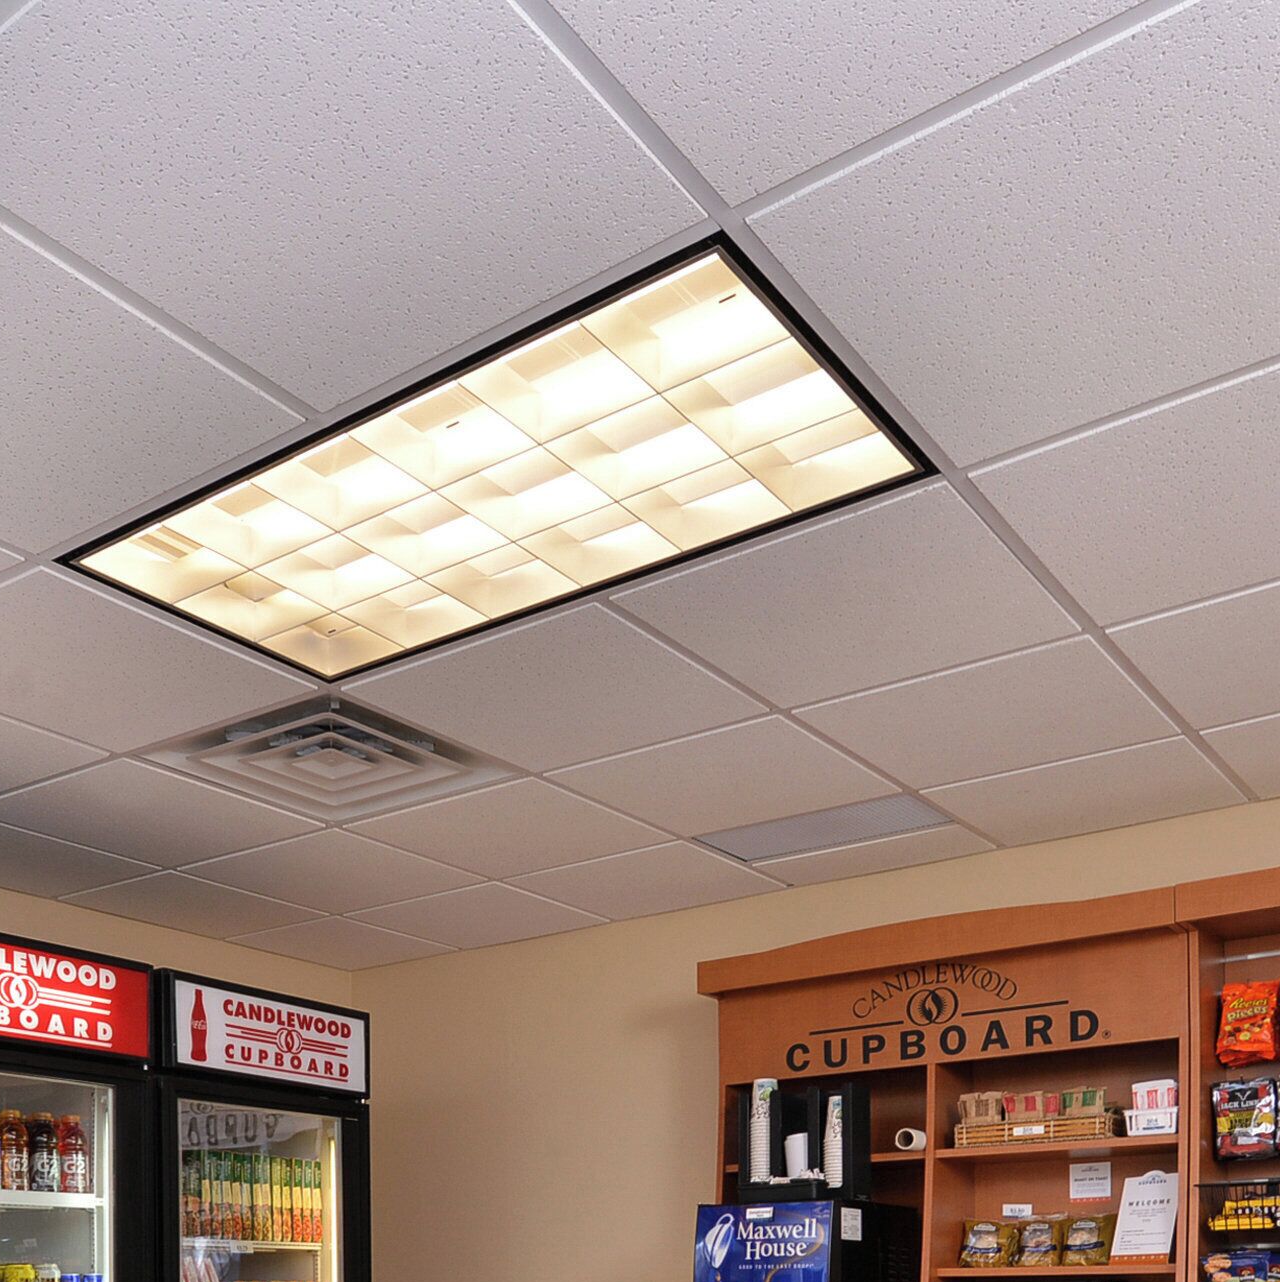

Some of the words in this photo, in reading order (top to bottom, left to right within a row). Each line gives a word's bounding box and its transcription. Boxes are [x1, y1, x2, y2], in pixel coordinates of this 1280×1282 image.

[851, 962, 1019, 1019] CANDLEWOOD
[222, 998, 352, 1039] CANDLEWOOD
[785, 1008, 1100, 1073] CUPBOARD
[224, 1043, 350, 1080] CUPBOARD
[63, 1158, 86, 1174] G2
[1128, 1198, 1171, 1207] WELCOME
[736, 1218, 817, 1240] Maxwell
[745, 1241, 808, 1261] House
